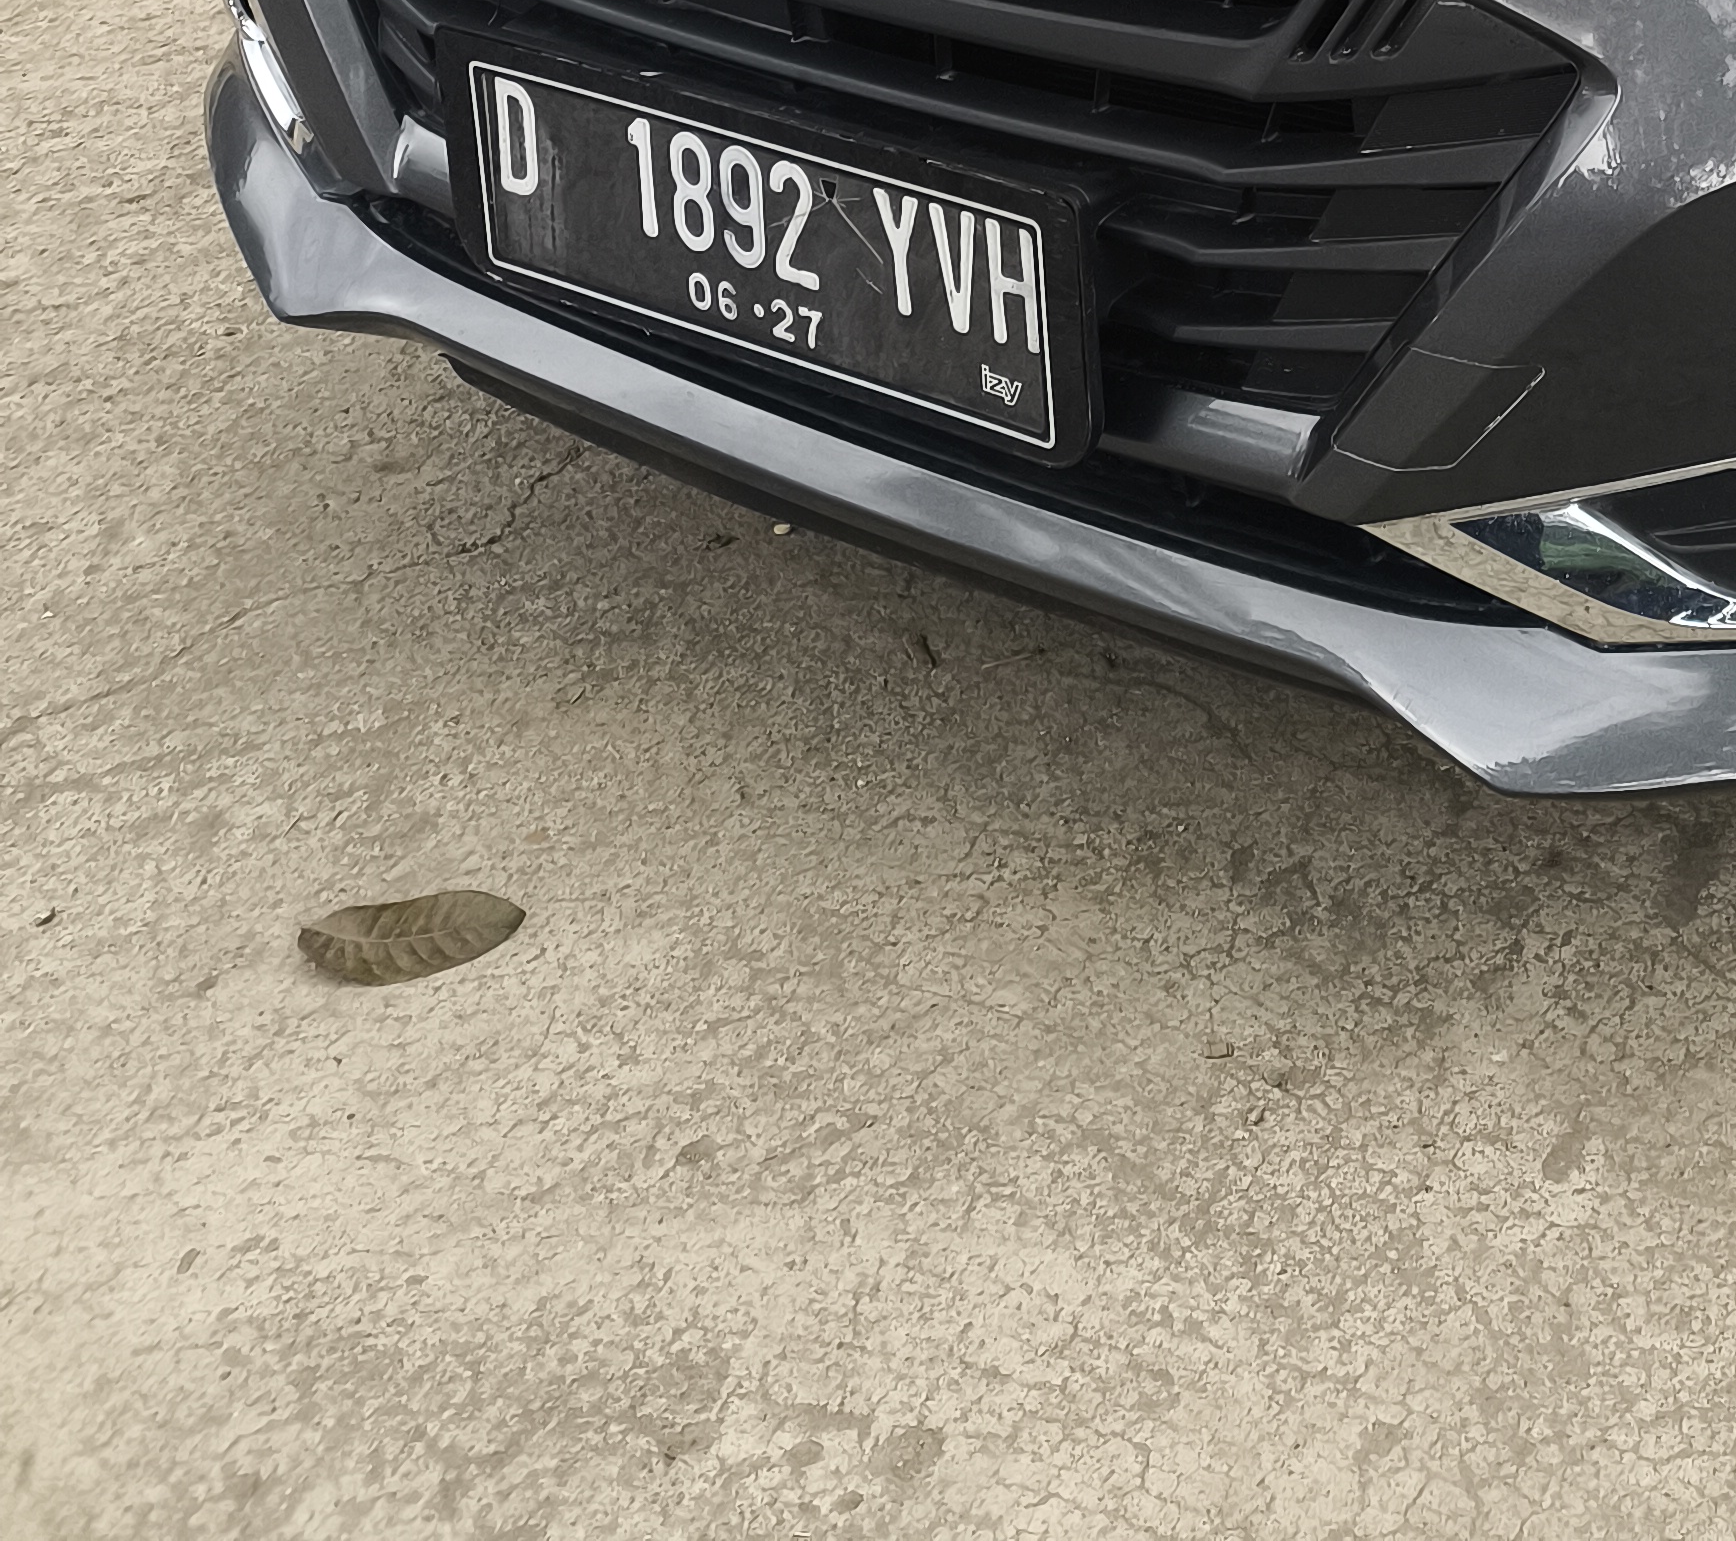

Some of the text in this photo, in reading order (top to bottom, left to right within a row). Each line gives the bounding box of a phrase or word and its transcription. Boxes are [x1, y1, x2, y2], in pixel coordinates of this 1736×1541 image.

[495, 76, 1041, 354] D 1892 YVH
